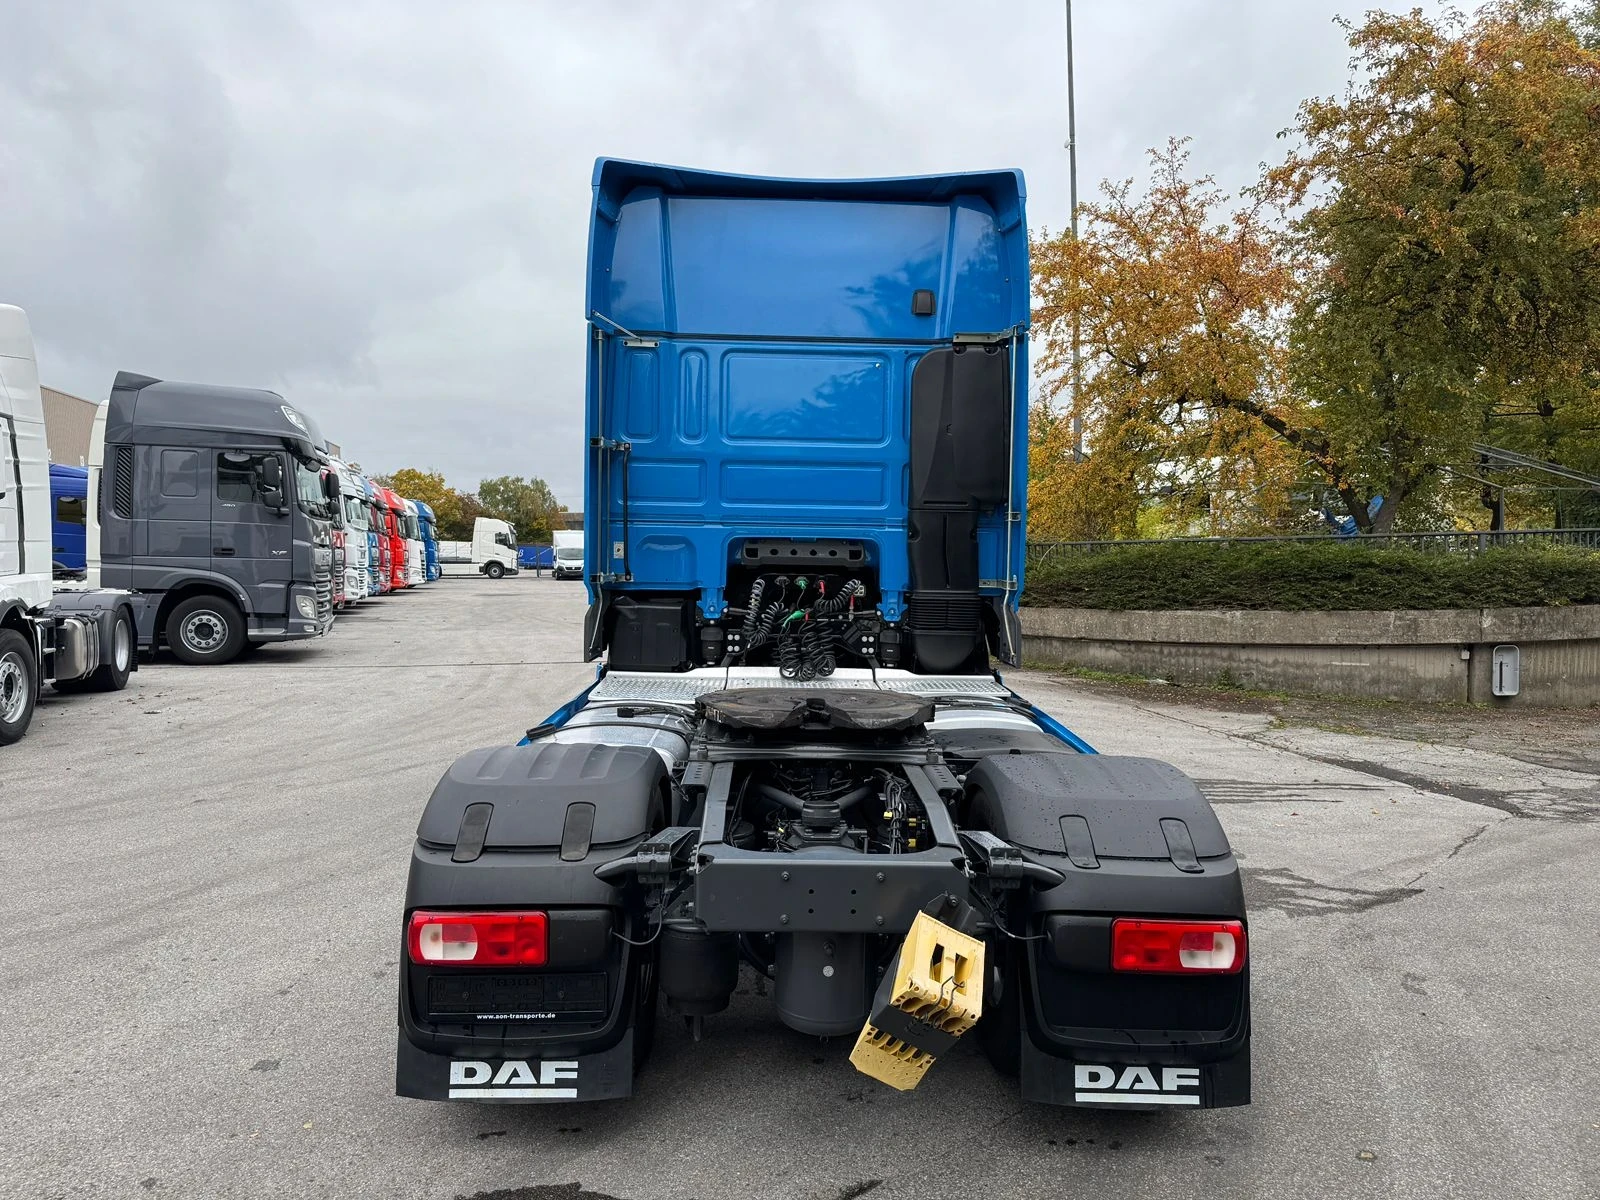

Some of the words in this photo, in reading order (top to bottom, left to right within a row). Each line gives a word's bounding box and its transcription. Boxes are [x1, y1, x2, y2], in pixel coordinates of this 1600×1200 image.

[476, 1012, 556, 1020] www.aon-transporte.de
[449, 1060, 579, 1085] DAF
[1074, 1064, 1200, 1091] DAF
